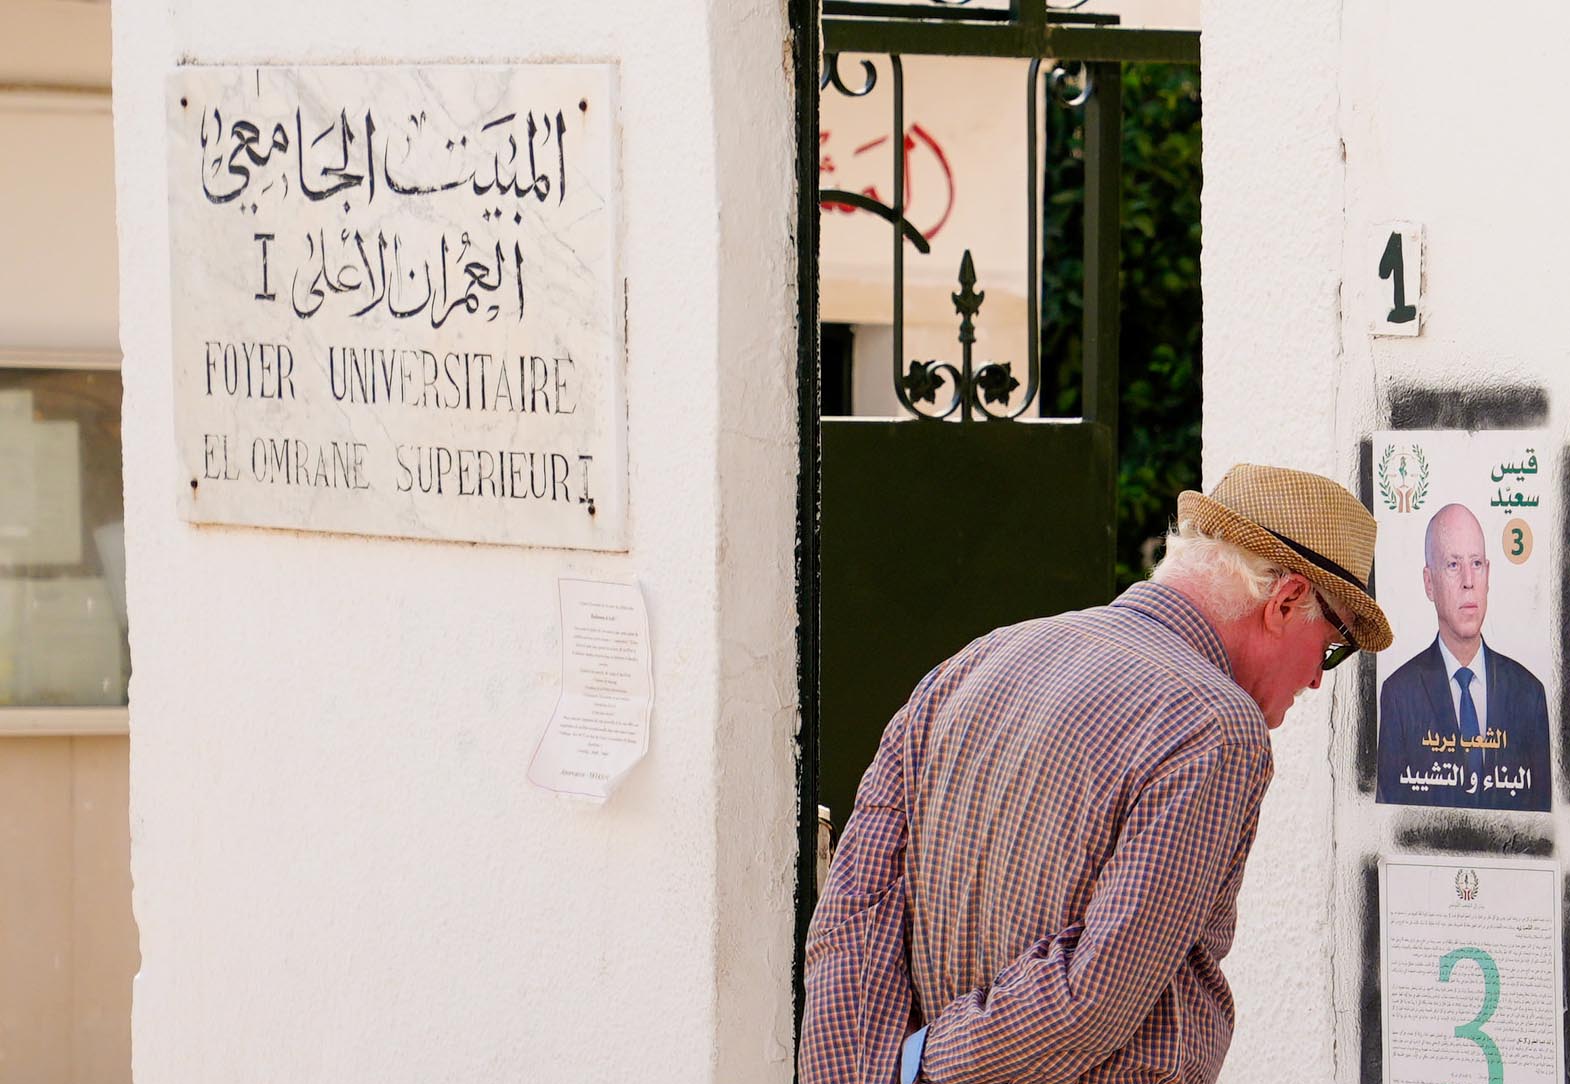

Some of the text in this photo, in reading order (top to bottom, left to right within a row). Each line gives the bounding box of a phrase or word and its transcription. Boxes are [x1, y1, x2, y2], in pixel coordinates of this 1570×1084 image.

[1378, 230, 1417, 324] 1
[204, 341, 577, 415] FOYER UNIVERSITAIRE
[203, 433, 240, 482] EL
[251, 437, 371, 491] OMRANE
[396, 444, 570, 503] SUPERIEUR
[1490, 447, 1539, 483] قيس
[1511, 528, 1525, 556] 3
[1421, 727, 1508, 753] الشعب يريد
[1399, 761, 1532, 797] البناء و التشييد
